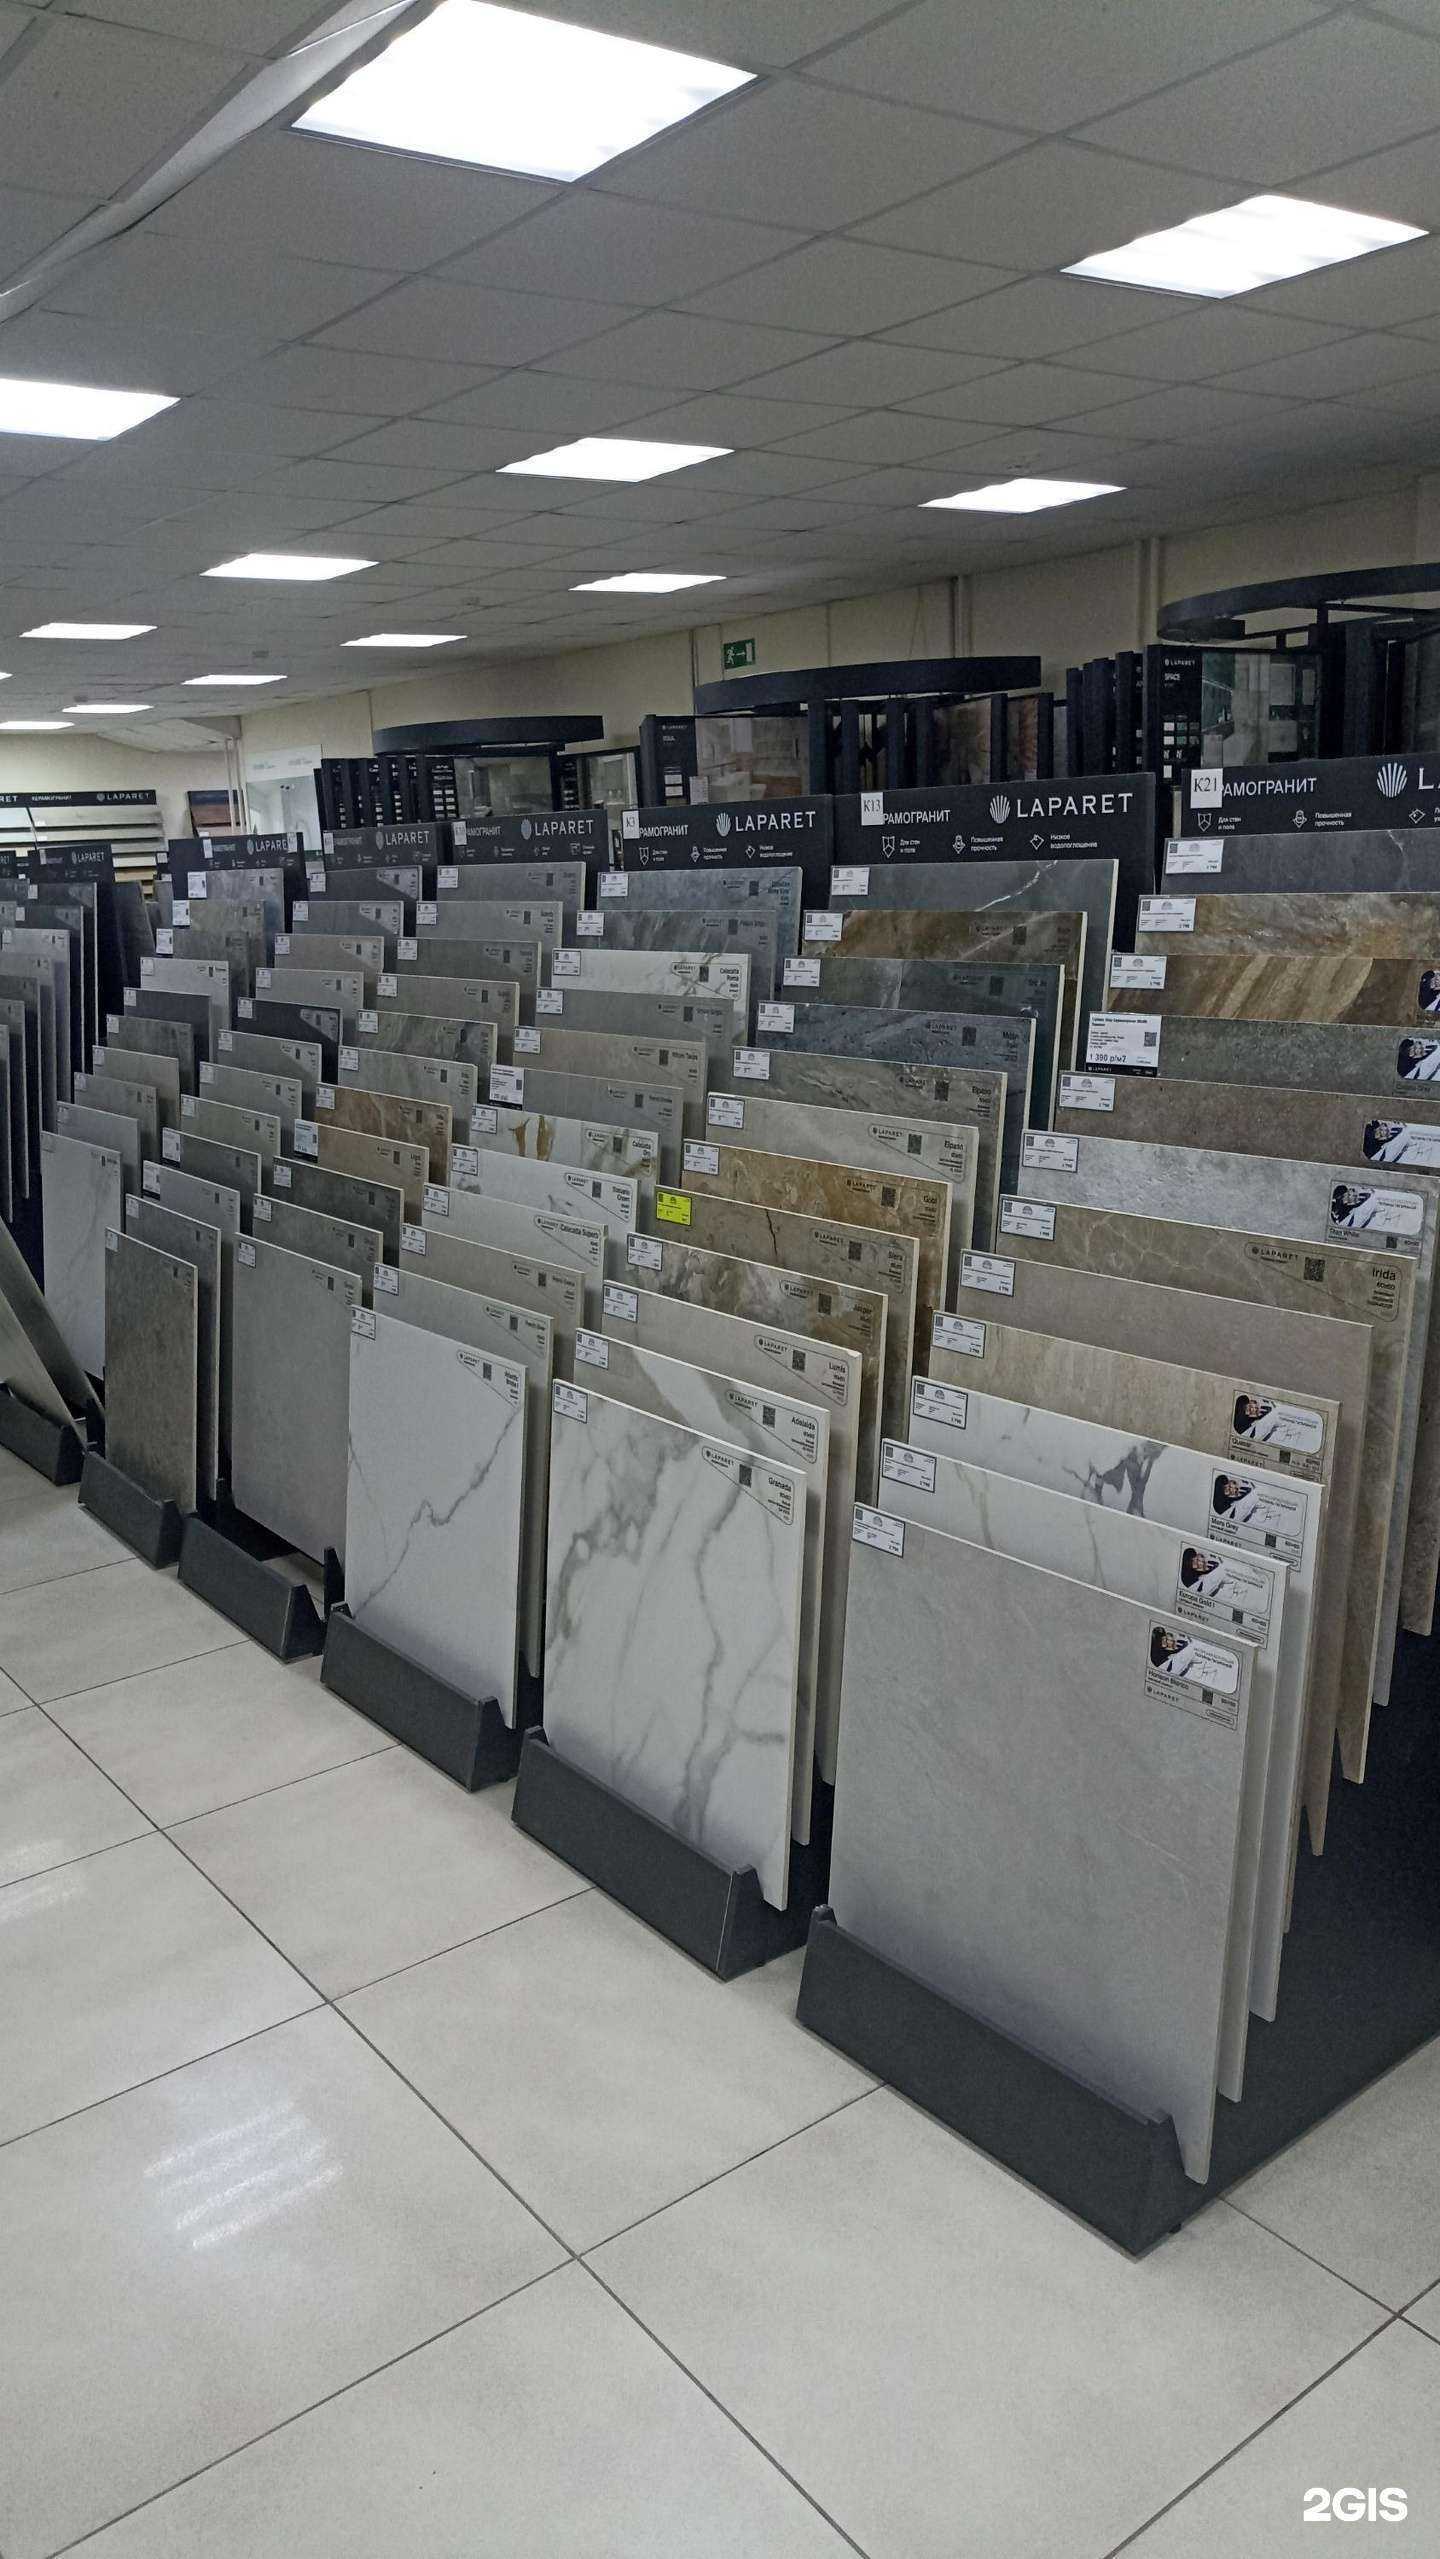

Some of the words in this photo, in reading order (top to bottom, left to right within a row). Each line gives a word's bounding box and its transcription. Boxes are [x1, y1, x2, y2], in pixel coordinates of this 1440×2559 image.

[1223, 777, 1317, 797] АМОГРАНИТ
[107, 793, 150, 801] LAPARET
[1017, 793, 1133, 818] LAPARET
[735, 811, 816, 832] LAPARET
[883, 809, 951, 825] РАМОГРАНИТ
[1315, 811, 1352, 819] Повышенная
[535, 820, 594, 836] LAPARET
[1315, 819, 1344, 827] прочность
[639, 824, 689, 837] РАМОГРАНИТ
[255, 839, 288, 850] LAPARE
[385, 831, 430, 846] LAPARET
[77, 851, 104, 863] LAPARET
[1372, 1267, 1396, 1281] Irida
[768, 1477, 792, 1492] Granada
